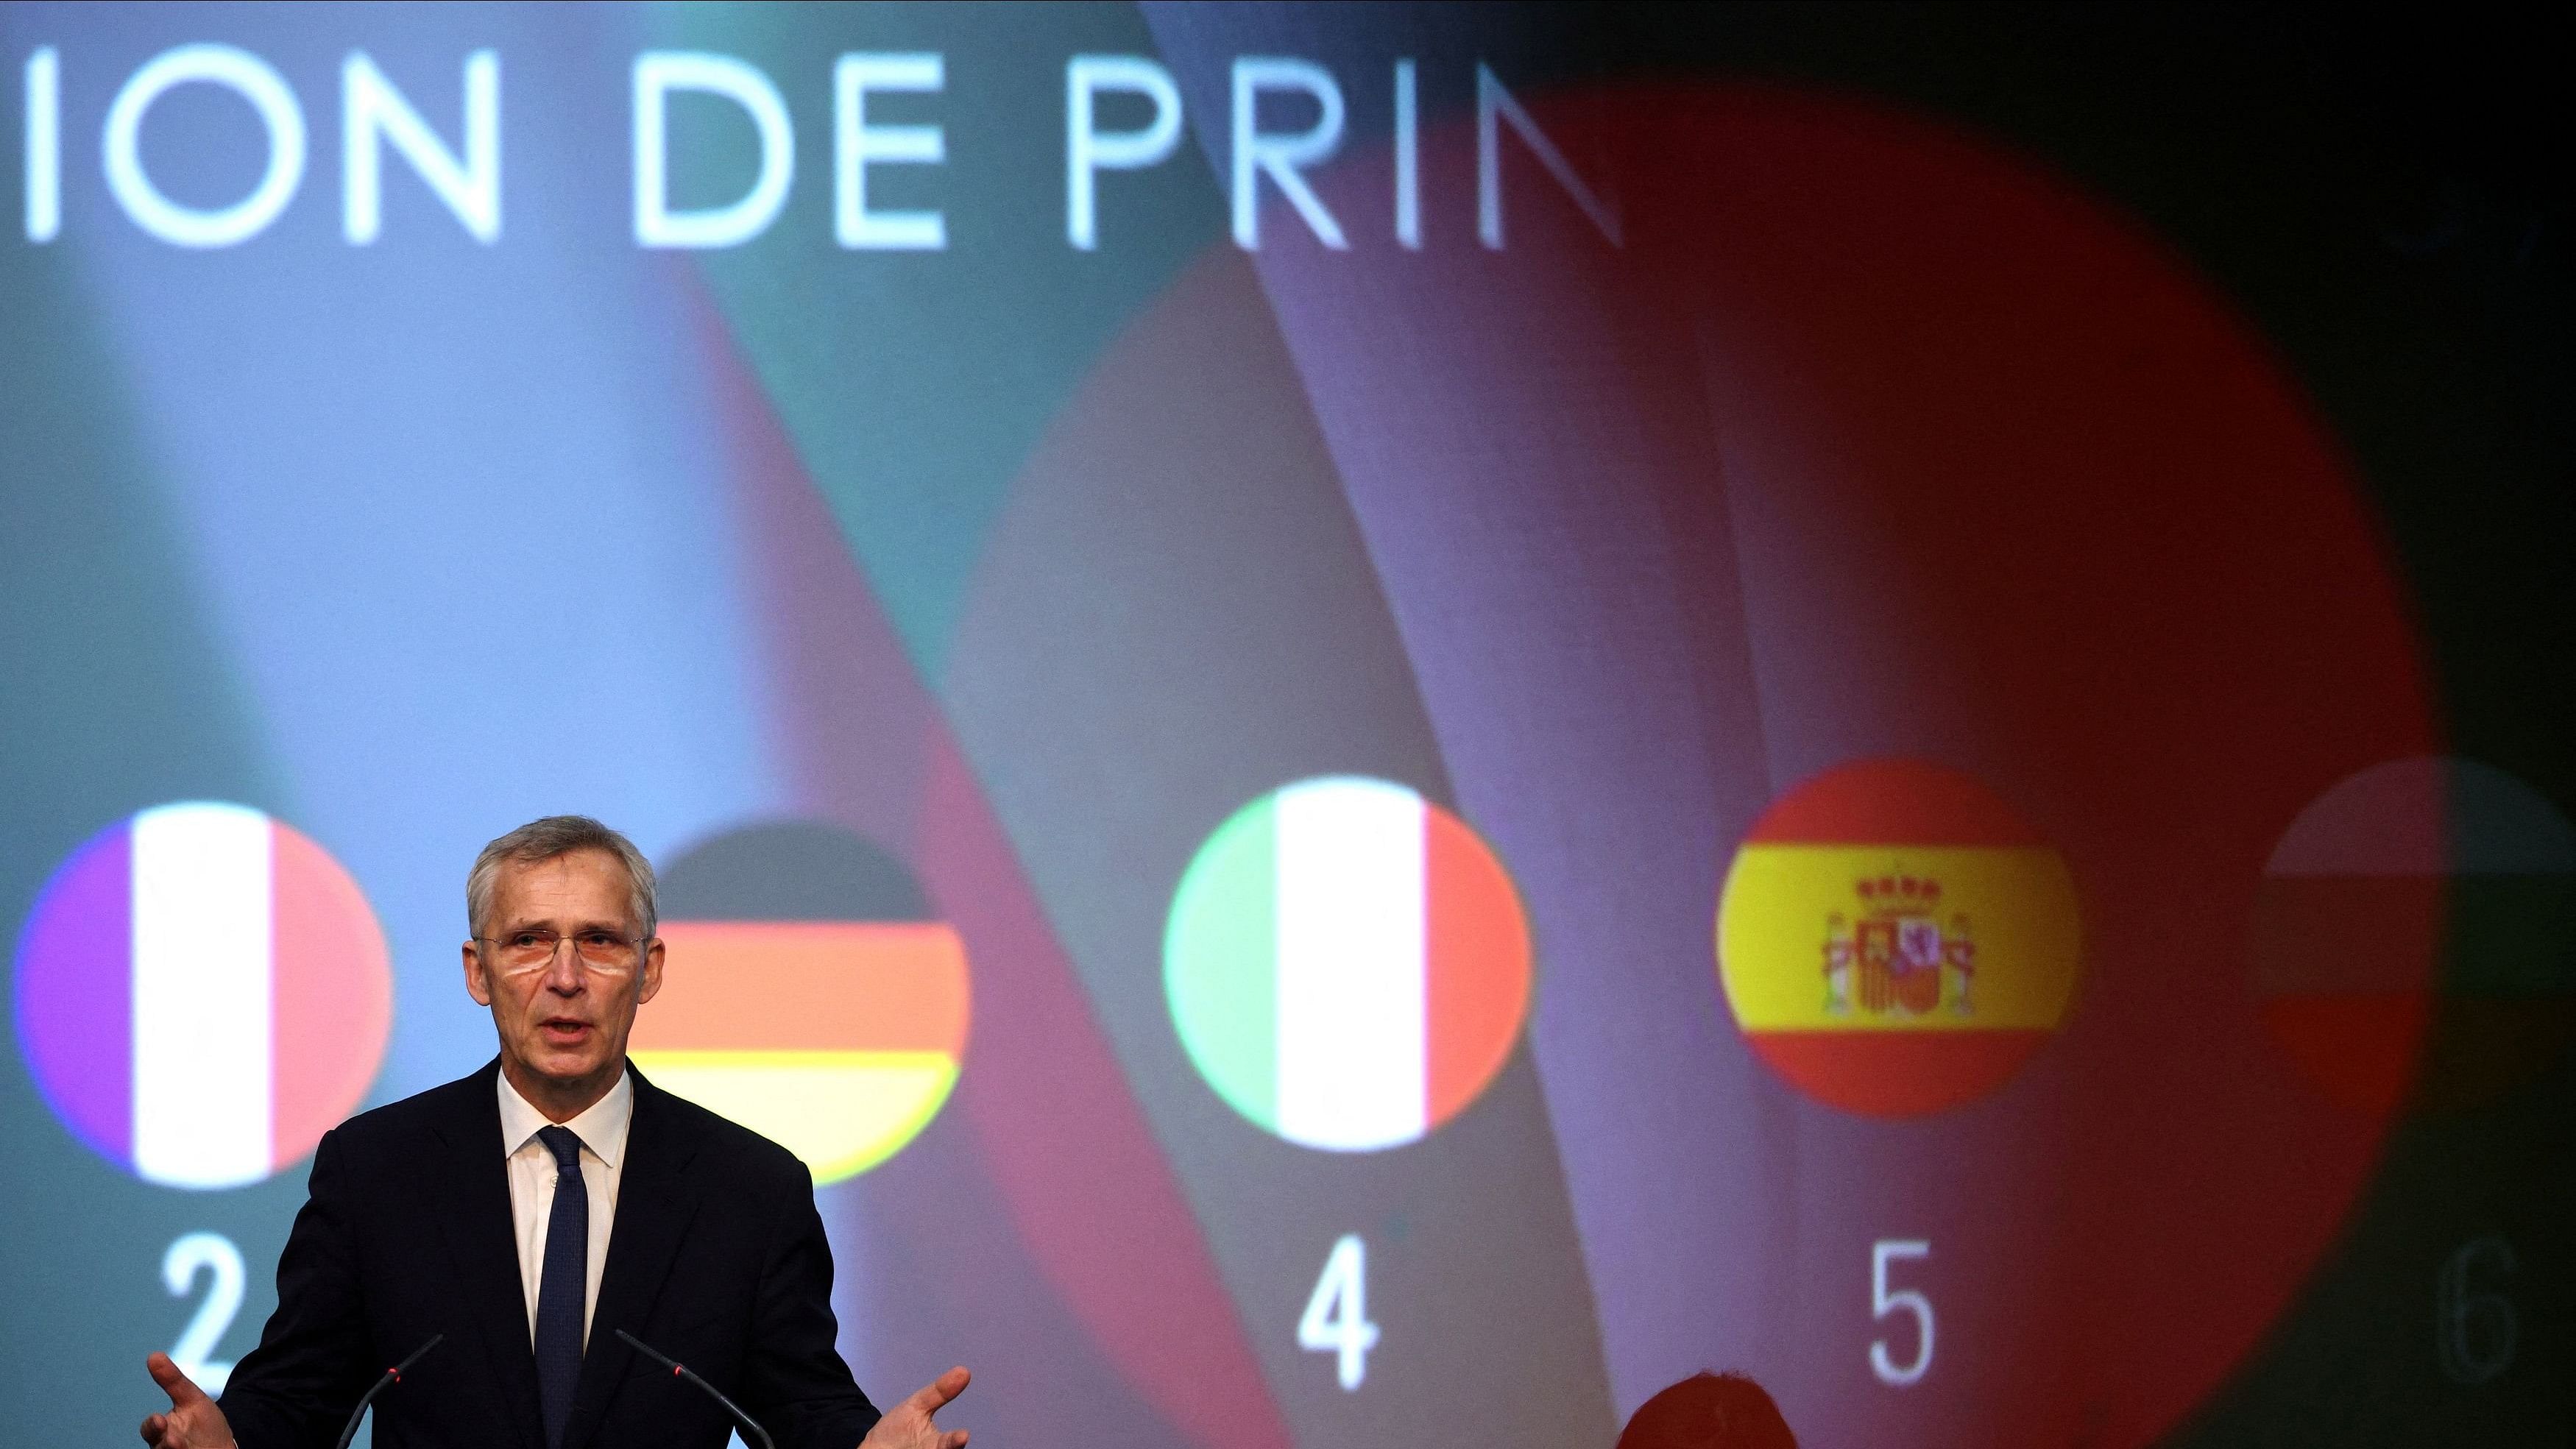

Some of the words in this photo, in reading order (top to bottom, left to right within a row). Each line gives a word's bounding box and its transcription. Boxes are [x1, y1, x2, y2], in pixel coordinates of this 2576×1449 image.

[25, 43, 500, 248] ION
[631, 50, 947, 249] DE
[162, 1230, 246, 1397] 2
[1297, 1233, 1381, 1392] 4
[1869, 1239, 1935, 1386] 5
[2436, 1234, 2519, 1385] 6
